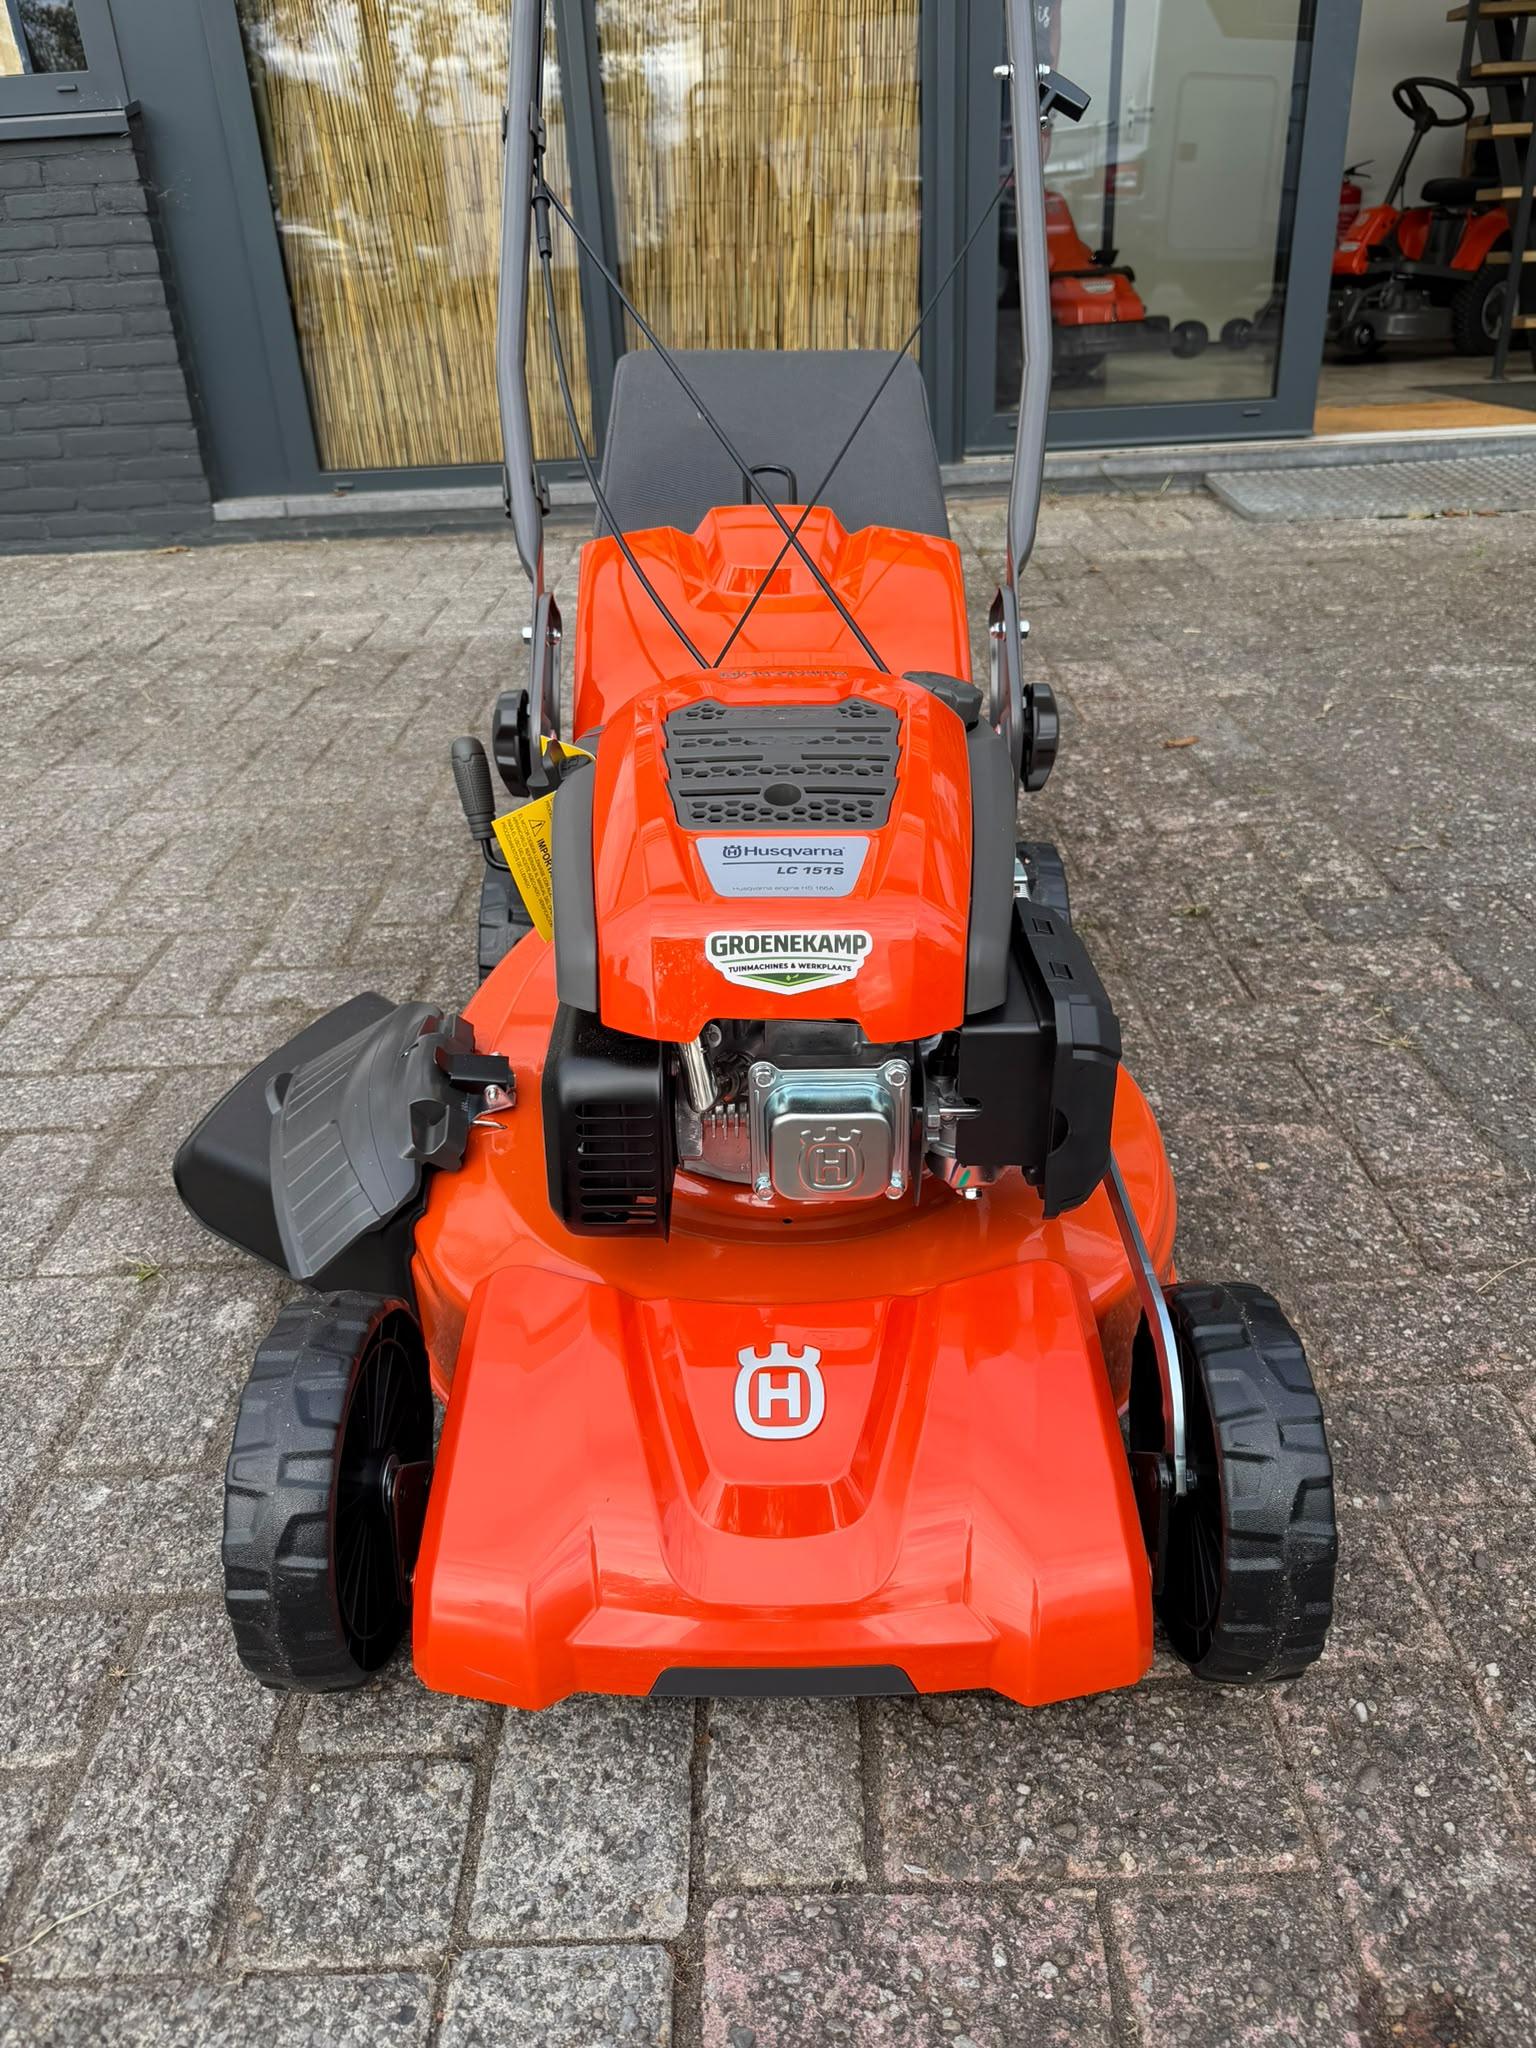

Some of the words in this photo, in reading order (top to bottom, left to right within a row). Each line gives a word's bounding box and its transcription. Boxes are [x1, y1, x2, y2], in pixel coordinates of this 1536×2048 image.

[744, 845, 844, 857] Husqvarna
[777, 866, 799, 875] LC
[803, 866, 845, 876] 151S
[710, 934, 867, 957] GROENEKAMP
[728, 962, 789, 973] TUINMACHINES
[798, 962, 852, 972] WERKPLAATS
